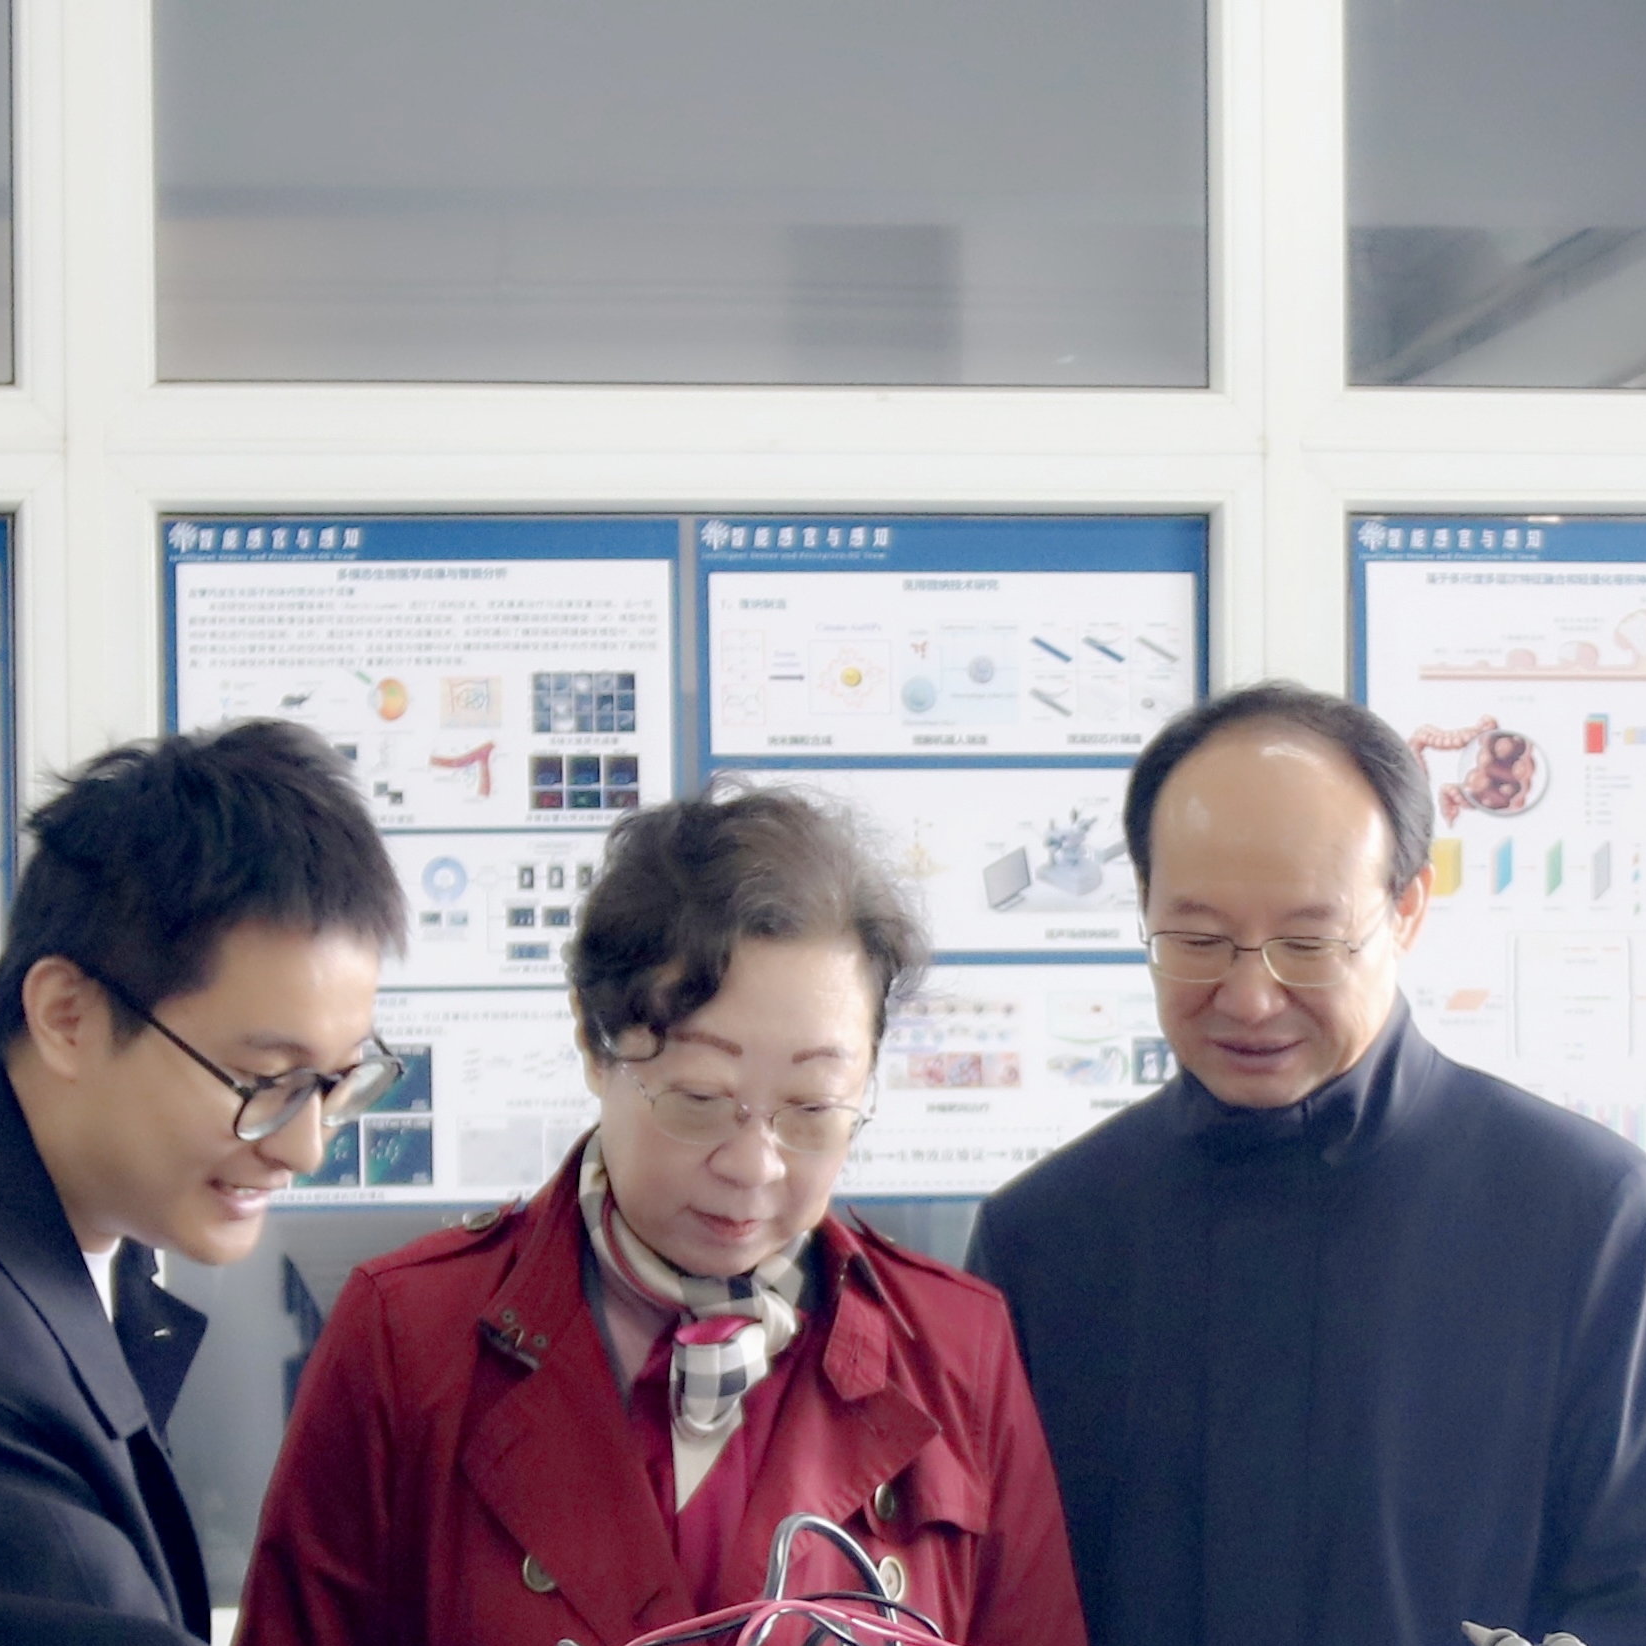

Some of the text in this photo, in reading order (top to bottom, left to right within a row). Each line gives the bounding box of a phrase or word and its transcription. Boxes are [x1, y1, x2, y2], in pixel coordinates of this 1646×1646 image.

[198, 527, 361, 551] 智能感官与感知
[729, 526, 891, 549] 智能感官与感知
[1387, 528, 1545, 550] 智能感官与感知
